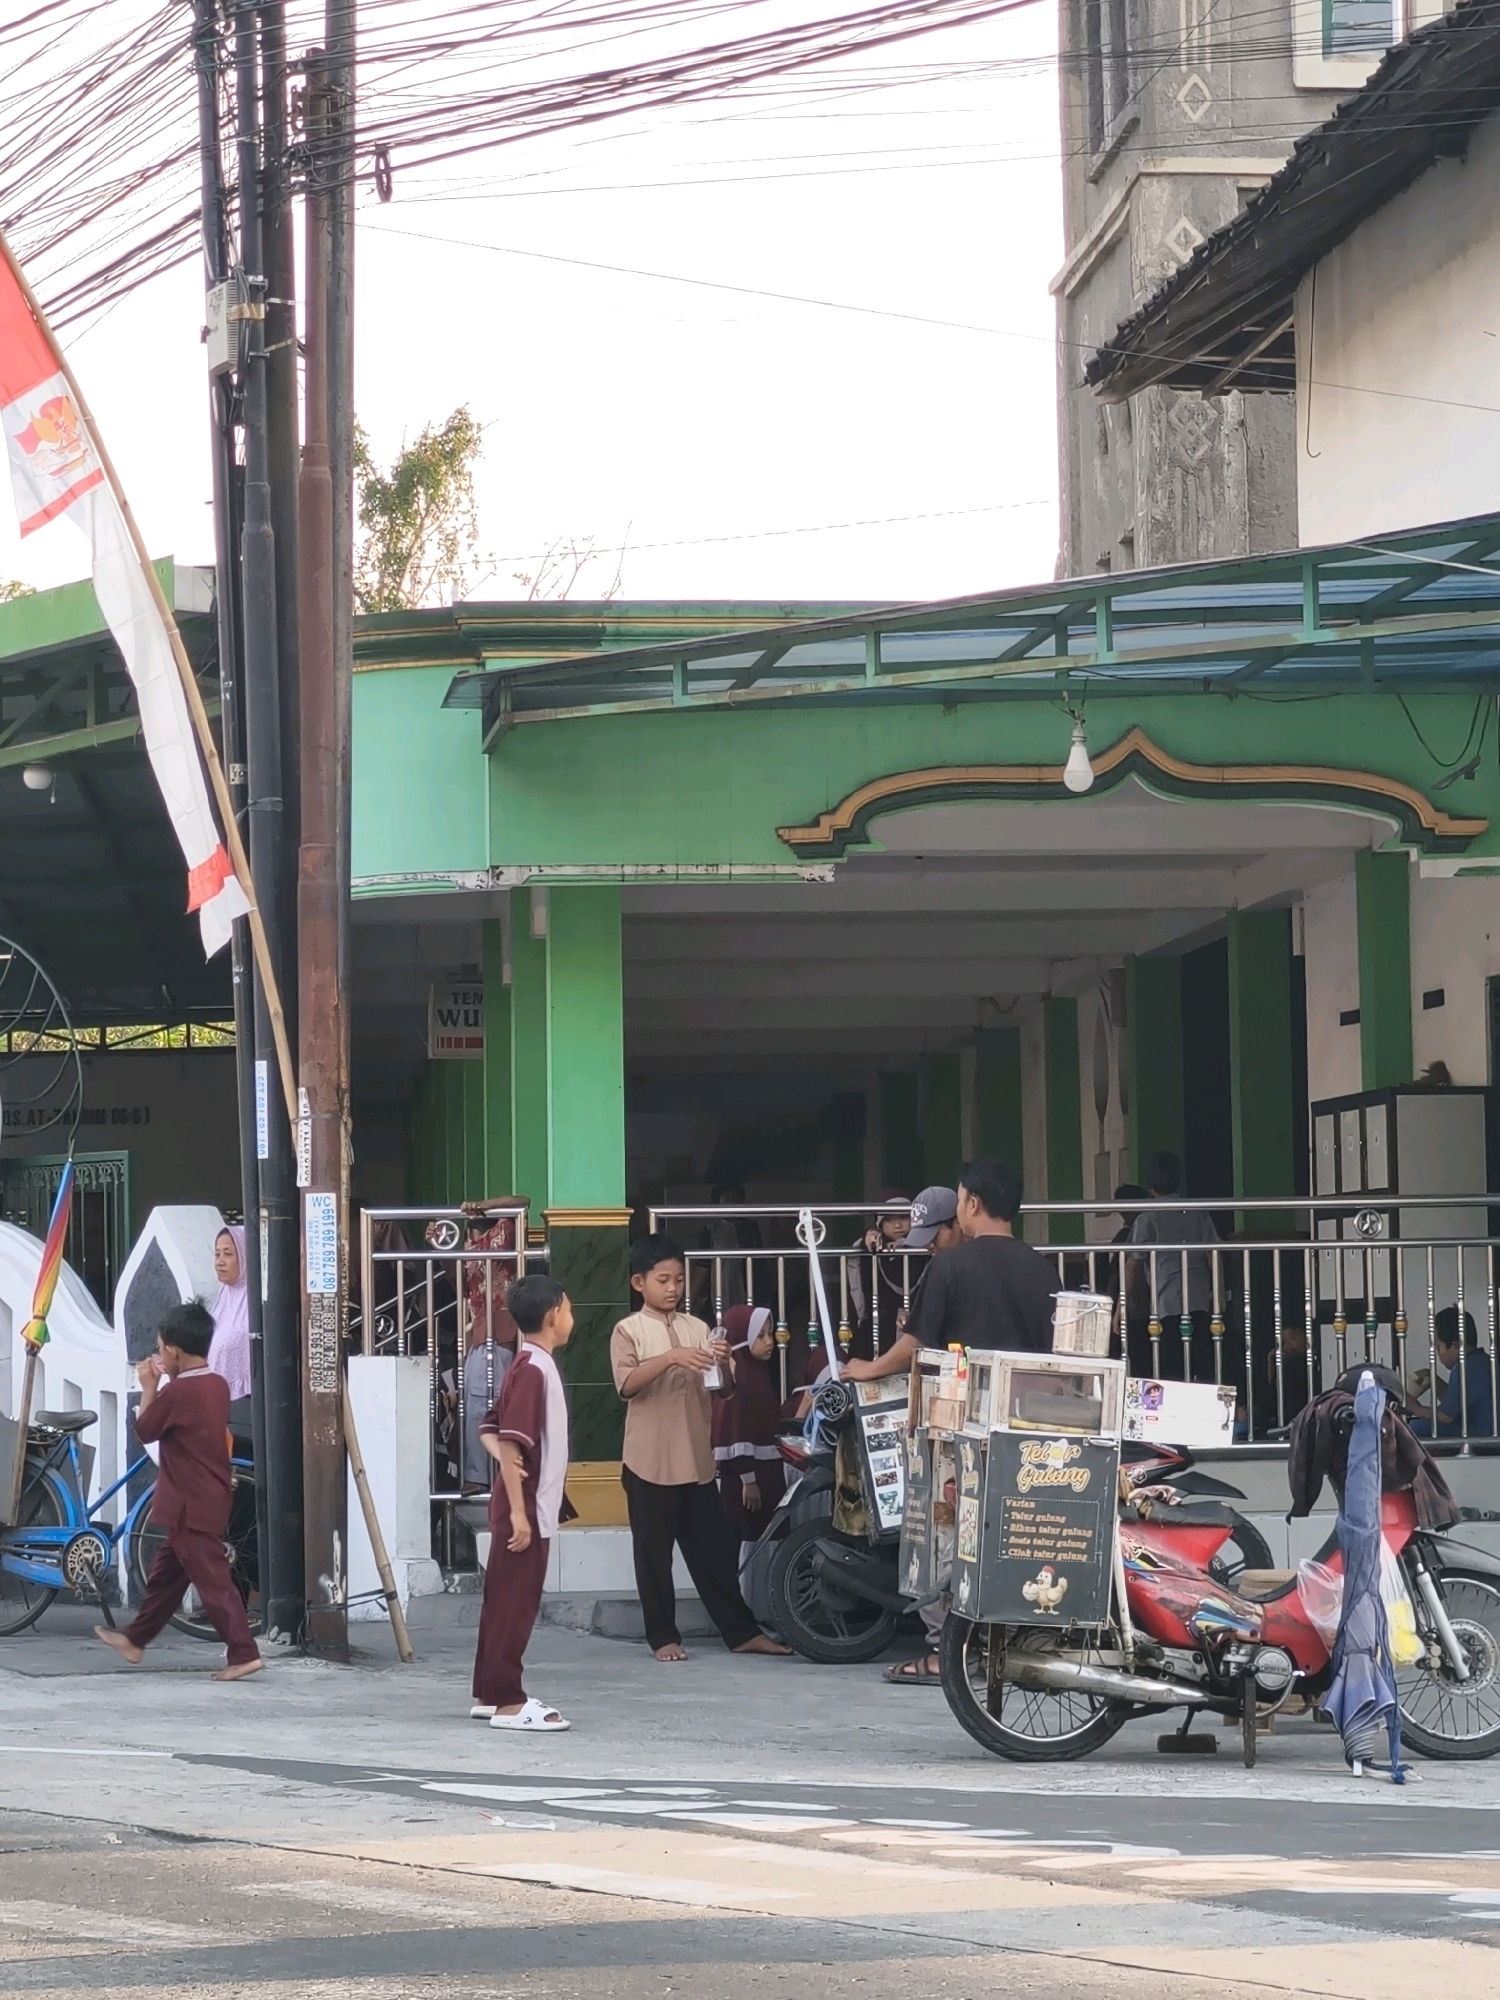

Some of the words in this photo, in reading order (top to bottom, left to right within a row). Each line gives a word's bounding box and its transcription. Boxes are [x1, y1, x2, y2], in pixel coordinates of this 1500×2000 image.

[437, 1009, 484, 1028] WU
[311, 1196, 331, 1207] WC
[322, 1208, 334, 1226] 199
[322, 1229, 335, 1248] 789
[323, 1250, 335, 1268] 789
[323, 1272, 335, 1290] 087
[311, 1332, 322, 1349] 993
[324, 1350, 335, 1368] 784
[312, 1369, 322, 1388] 082
[1017, 1464, 1091, 1493] Gulung
